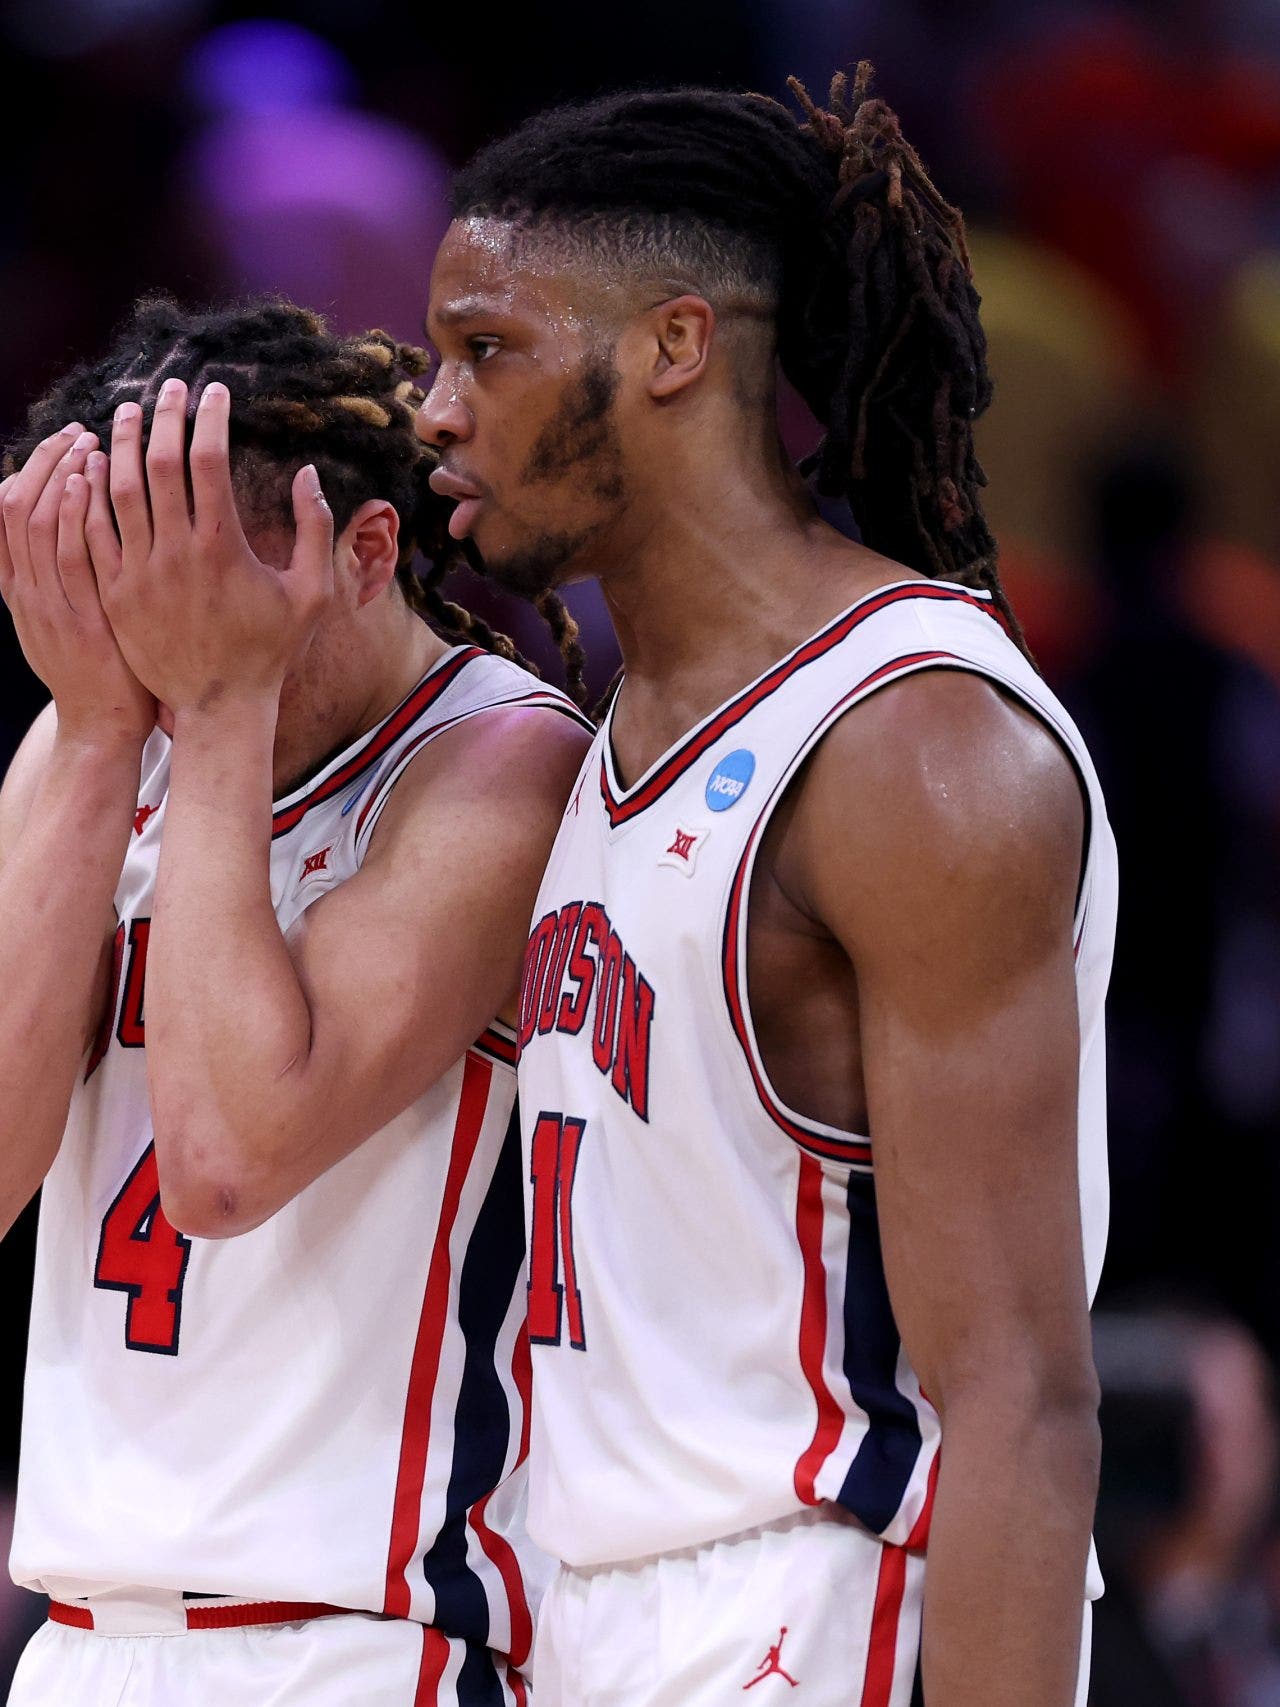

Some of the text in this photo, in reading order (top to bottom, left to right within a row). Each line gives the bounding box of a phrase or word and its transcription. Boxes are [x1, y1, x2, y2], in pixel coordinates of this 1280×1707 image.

[666, 828, 698, 861] XII
[709, 774, 745, 798] NCAA
[516, 900, 656, 1124] OUSON
[94, 1138, 193, 1357] 4
[526, 1110, 588, 1352] 11
